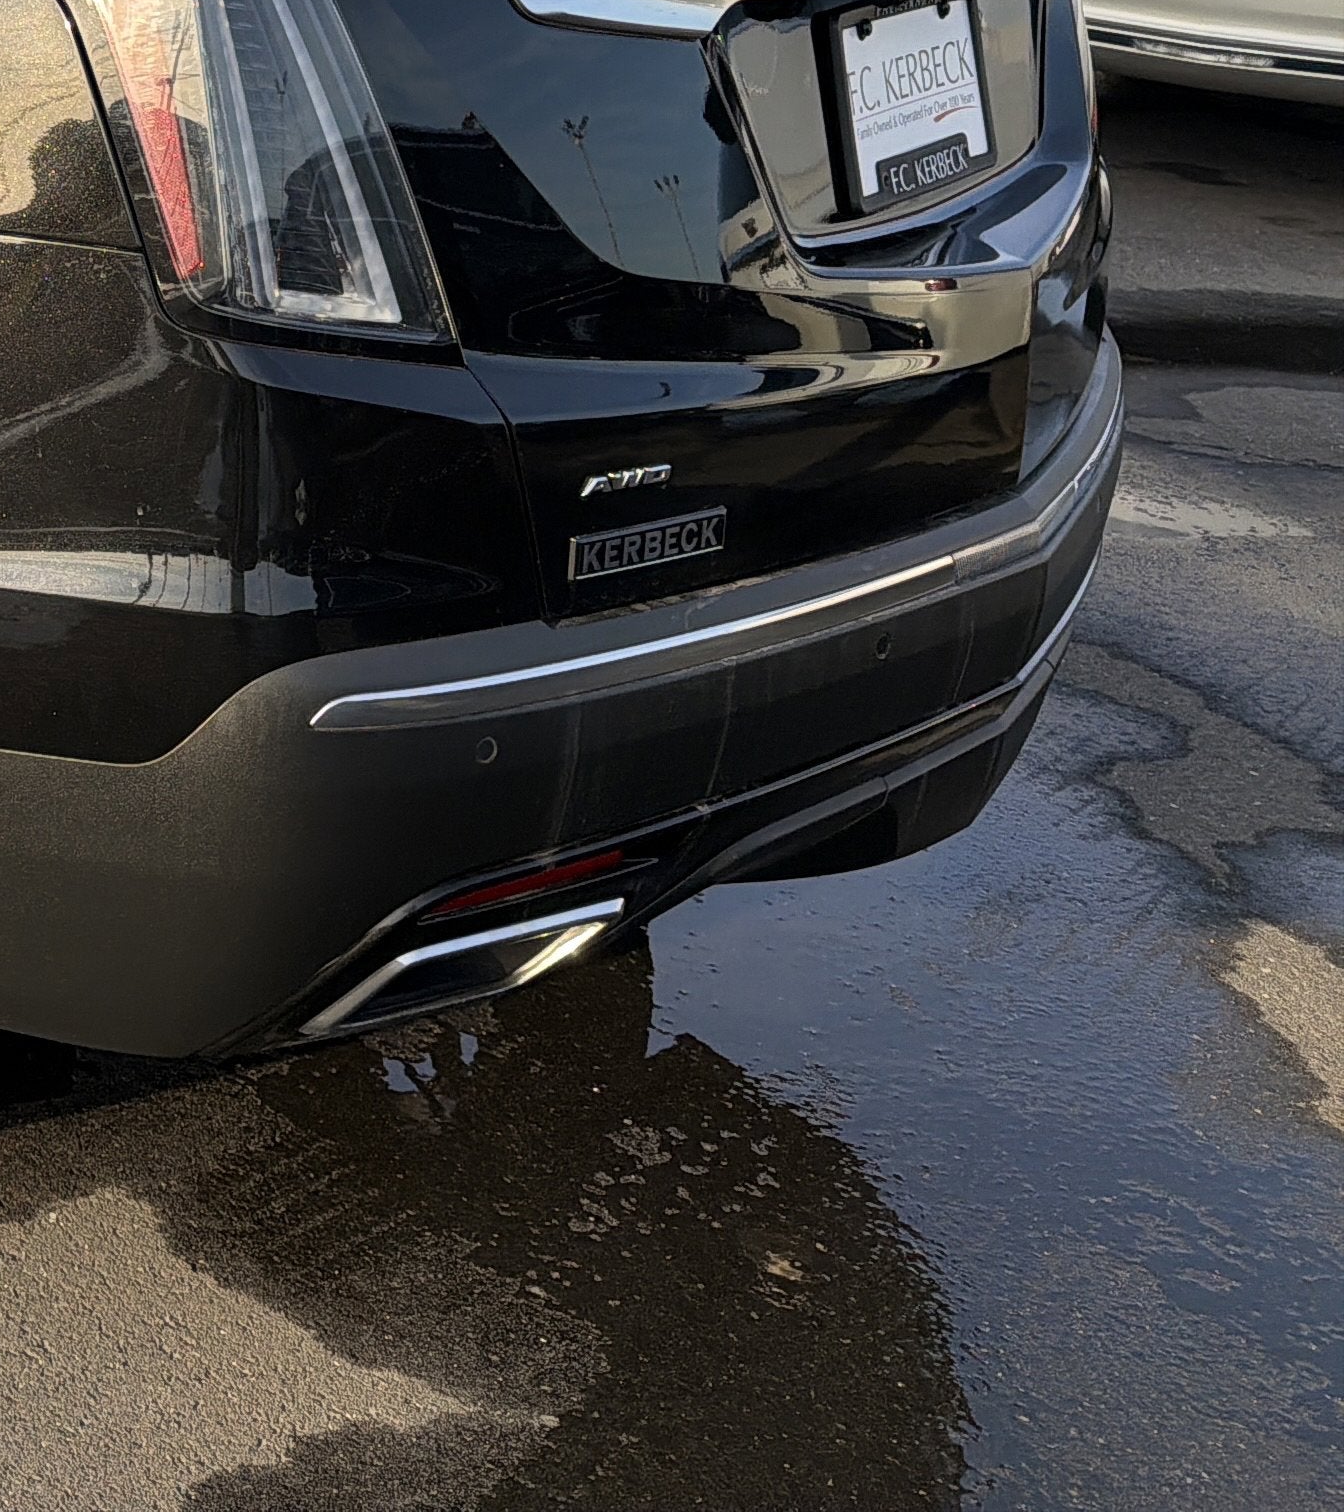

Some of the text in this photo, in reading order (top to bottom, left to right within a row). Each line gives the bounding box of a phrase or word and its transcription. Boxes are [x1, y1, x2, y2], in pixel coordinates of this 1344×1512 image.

[846, 37, 974, 116] F.C. KERBECK
[889, 142, 969, 195] F.C. KERBECK
[580, 463, 673, 497] AWD
[581, 516, 721, 574] KERBECK
